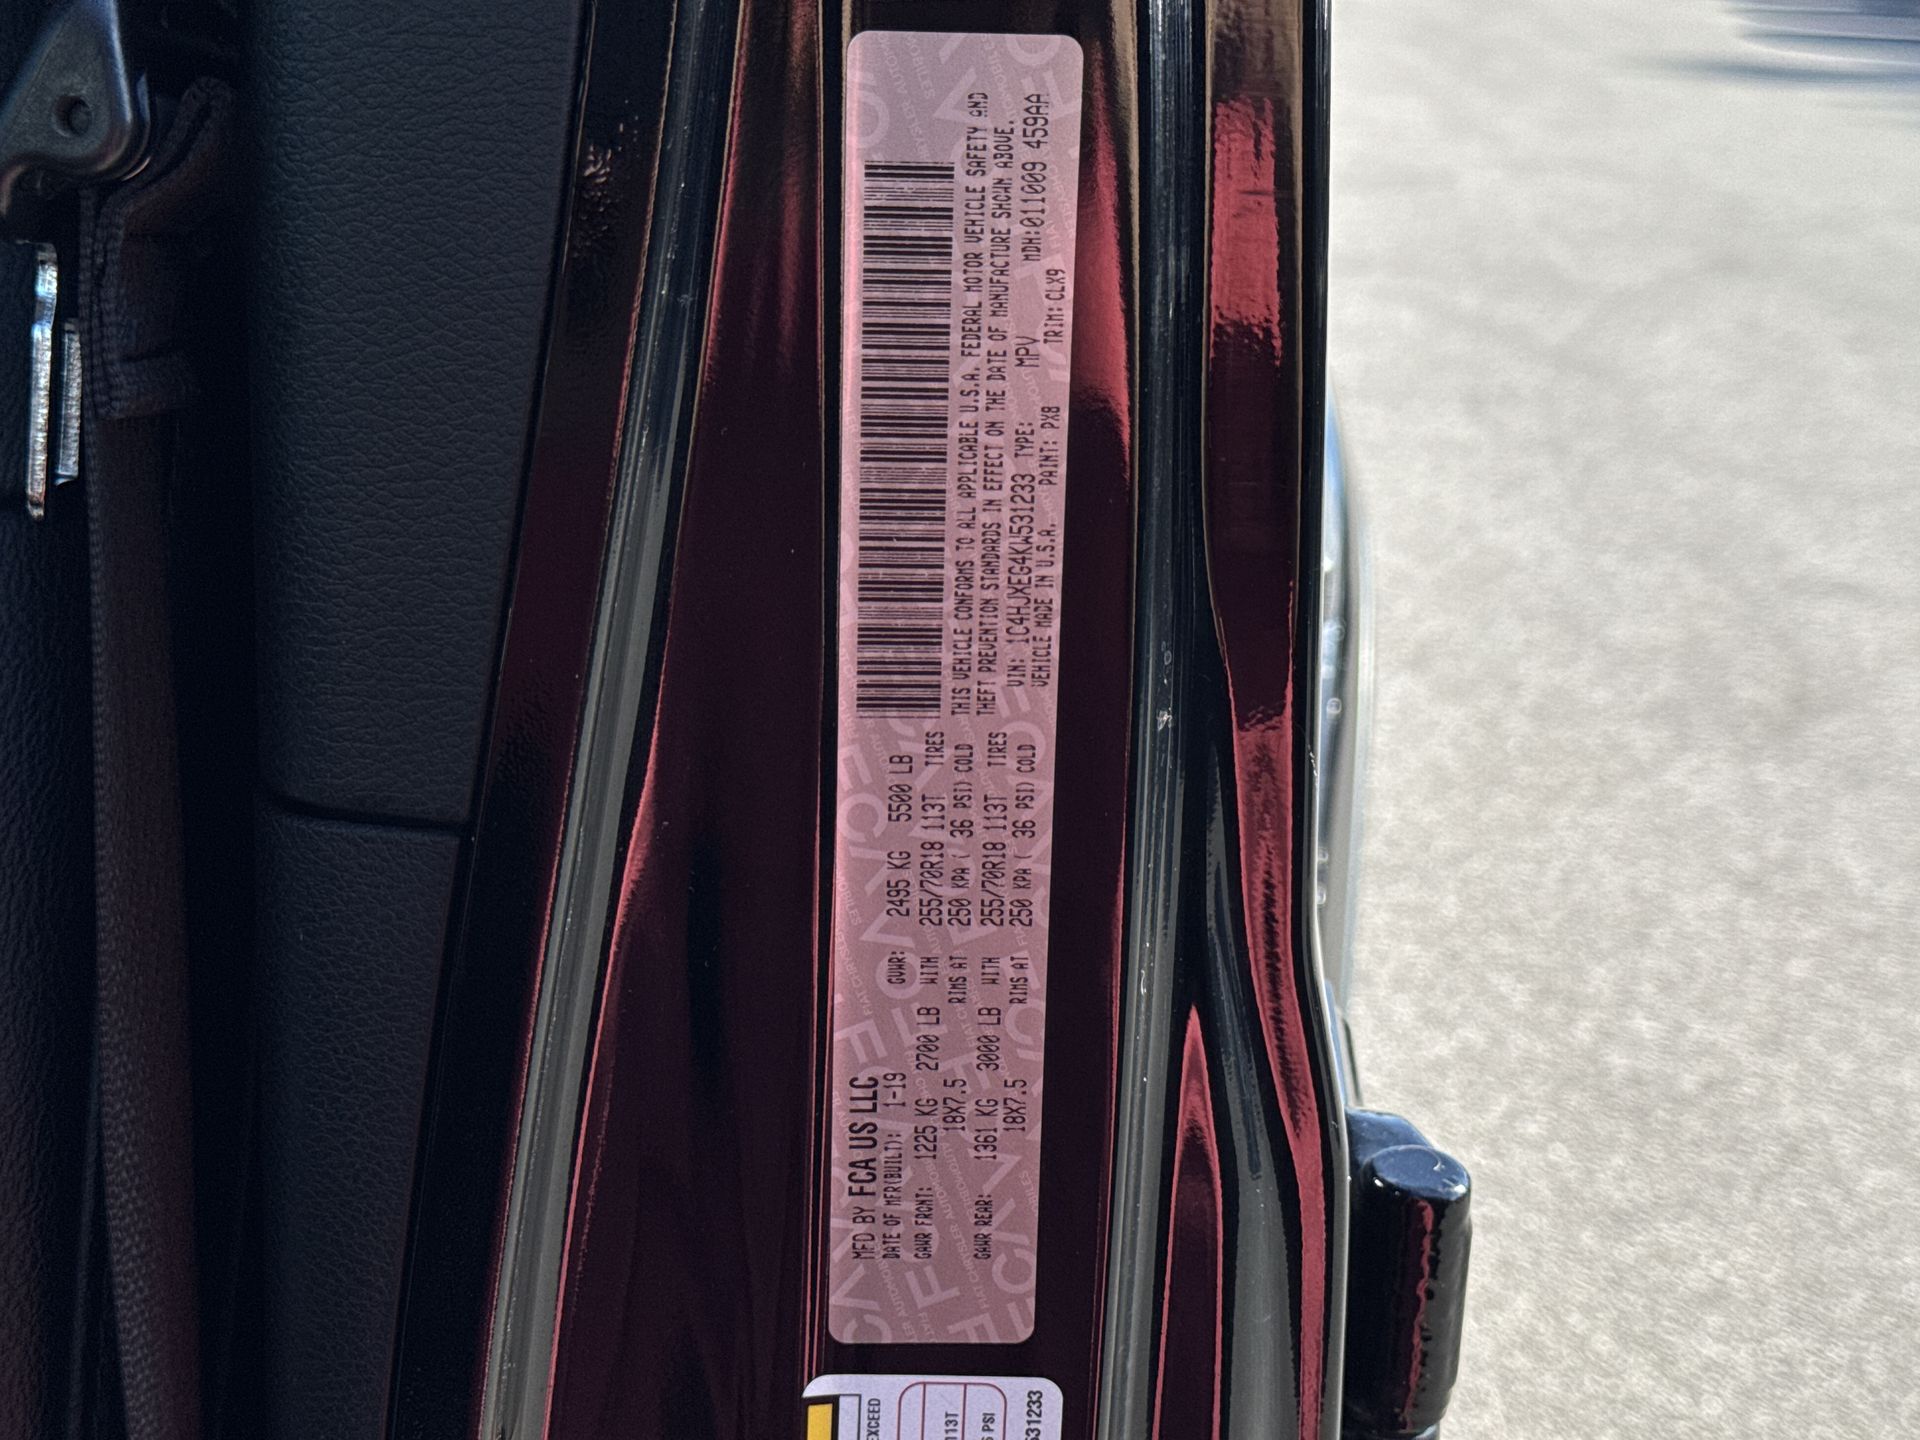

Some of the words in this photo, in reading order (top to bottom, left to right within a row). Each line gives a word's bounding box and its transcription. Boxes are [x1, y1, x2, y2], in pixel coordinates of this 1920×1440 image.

[1023, 93, 1049, 149] 459AA
[967, 126, 987, 176] SAFETY
[994, 120, 1014, 168] ABOVE.
[965, 186, 986, 243] VEHICLE
[964, 252, 983, 292] MOTOR
[989, 228, 1011, 317] MANUFACTURE
[1045, 269, 1065, 301] CLX9
[961, 302, 982, 357] FEDERAL
[988, 326, 1007, 341] OF
[1044, 307, 1064, 344] TRIM:
[987, 350, 1006, 380] DATE
[1015, 336, 1039, 367] MPV
[960, 367, 980, 412] U.S.A.
[986, 390, 1005, 411] THE
[985, 421, 1004, 436] ON
[1041, 406, 1060, 429] PX8
[1015, 422, 1034, 457] TYPE:
[958, 421, 978, 498] APPLICABLE
[984, 445, 1003, 491] EFFECT
[1039, 441, 1058, 485] PAINT:
[957, 507, 976, 528] ALL
[983, 499, 1001, 512] IN
[957, 537, 975, 551] TO
[982, 522, 1000, 590] STANDARDS
[1006, 474, 1035, 644] 1C4HJXEG4KW531233
[1037, 523, 1055, 567] U.S.A.
[955, 560, 974, 620] CONFORMS
[1035, 575, 1053, 588] IN
[1034, 597, 1052, 628] MADE
[979, 598, 998, 672] PREVENTION
[953, 628, 972, 679] VEHICLE
[1032, 636, 1051, 686] VEHICLE
[1007, 658, 1026, 686] VIN:
[951, 688, 970, 715] THIS
[977, 680, 996, 715] THEFT
[889, 754, 913, 774] LB
[925, 731, 944, 767] TIRES
[955, 744, 973, 773] COLD
[987, 732, 1007, 767] TIRES
[1017, 745, 1036, 773] COLD
[888, 784, 912, 822] 5500
[954, 781, 972, 809] PSI)
[1016, 782, 1035, 809] PSI)
[922, 793, 945, 830] 113T
[984, 793, 1007, 830] 113T
[950, 820, 973, 838] 36
[1012, 820, 1035, 838] 36
[888, 850, 910, 870] KG
[919, 842, 944, 926] 255/70R18
[951, 868, 970, 888] KPA
[981, 842, 1006, 927] 255/70R18
[1013, 868, 1031, 889] KPA
[887, 880, 910, 917] 2495
[948, 898, 971, 926] 250
[1009, 899, 1033, 927] 250
[887, 950, 906, 984] GVWR:
[920, 956, 939, 984] WITH
[949, 956, 968, 969] AT
[982, 957, 1000, 984] WITH
[1010, 956, 1029, 969] AT
[948, 976, 967, 1004] RIMS
[1010, 977, 1028, 1004] RIMS
[917, 1007, 940, 1025] LB
[978, 1007, 1000, 1025] LB
[916, 1034, 939, 1071] 2700
[977, 1034, 1000, 1071] 3000
[849, 1076, 878, 1113] LLC
[884, 1072, 906, 1107] 1-19
[915, 1098, 938, 1117] KG
[943, 1079, 966, 1132] 18X7.5
[976, 1099, 998, 1117] KG
[1004, 1079, 1026, 1132] 18X7.5
[849, 1122, 877, 1149] US
[915, 1125, 937, 1160] 1225
[976, 1127, 998, 1160] 1361
[848, 1158, 877, 1197] FCA
[852, 1206, 875, 1224] BY
[884, 1213, 901, 1226] OF
[915, 1187, 933, 1226] FRONT:
[975, 1193, 992, 1226] REAR:
[852, 1233, 875, 1260] MFD
[884, 1233, 901, 1259] DATE
[915, 1232, 932, 1259] GAWR
[974, 1233, 992, 1260] GAWR
[982, 1413, 995, 1432] PSI
[1025, 1390, 1043, 1440] 31233
